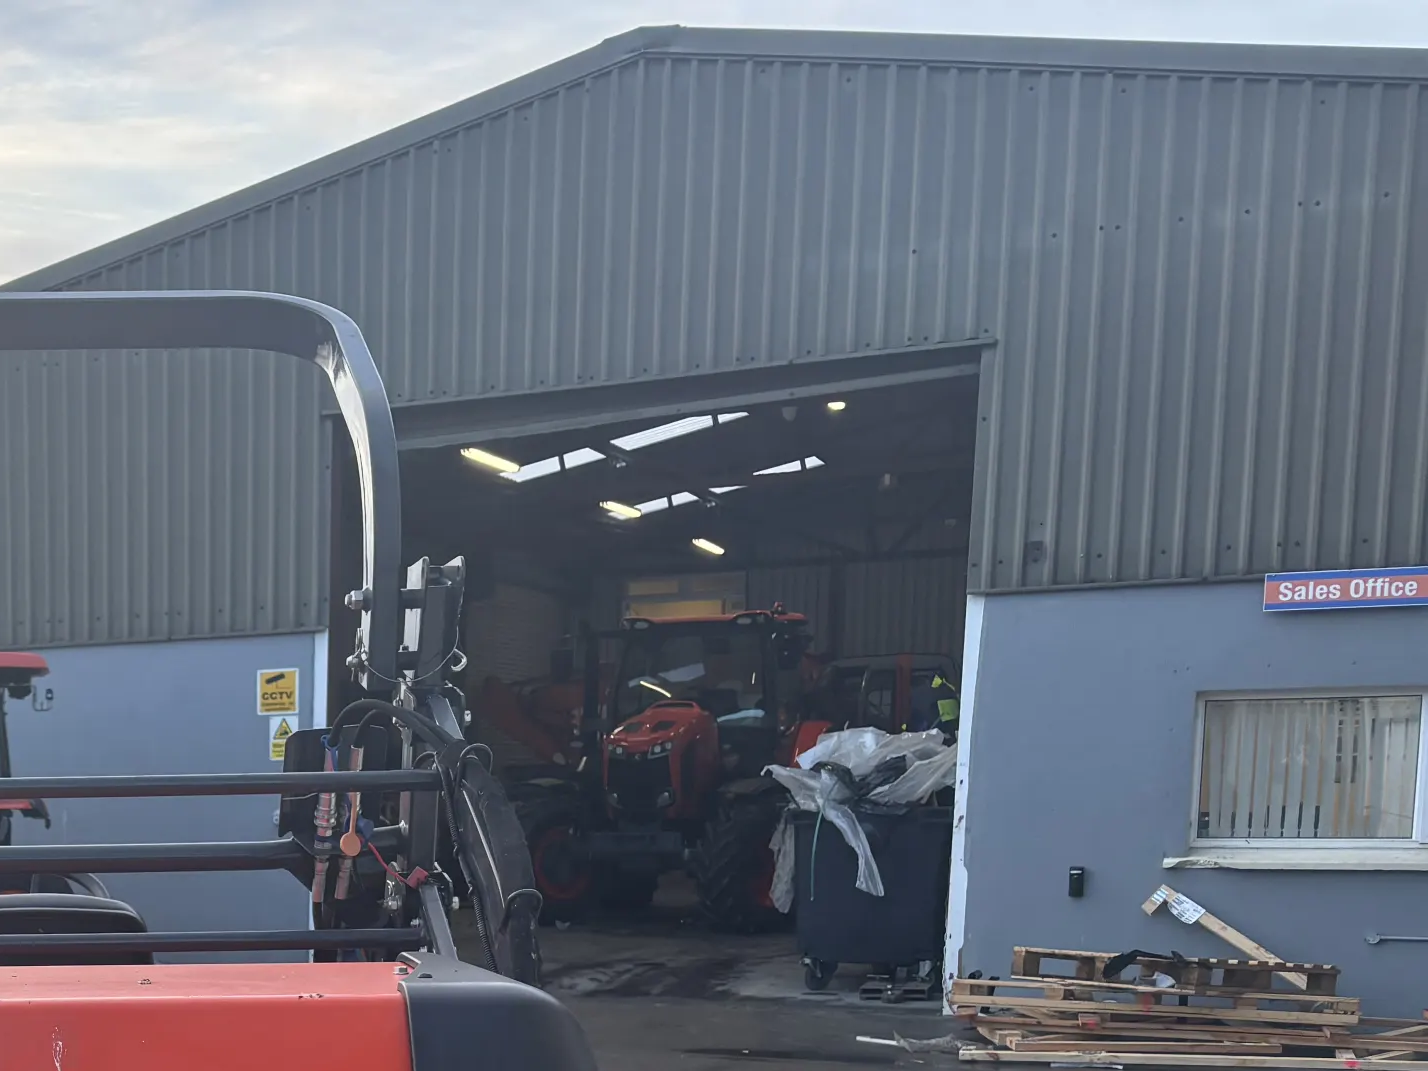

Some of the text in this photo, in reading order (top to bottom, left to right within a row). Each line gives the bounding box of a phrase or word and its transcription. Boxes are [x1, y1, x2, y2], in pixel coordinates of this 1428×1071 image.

[1278, 577, 1418, 601] Sales Office
[262, 691, 293, 701] CCTV
